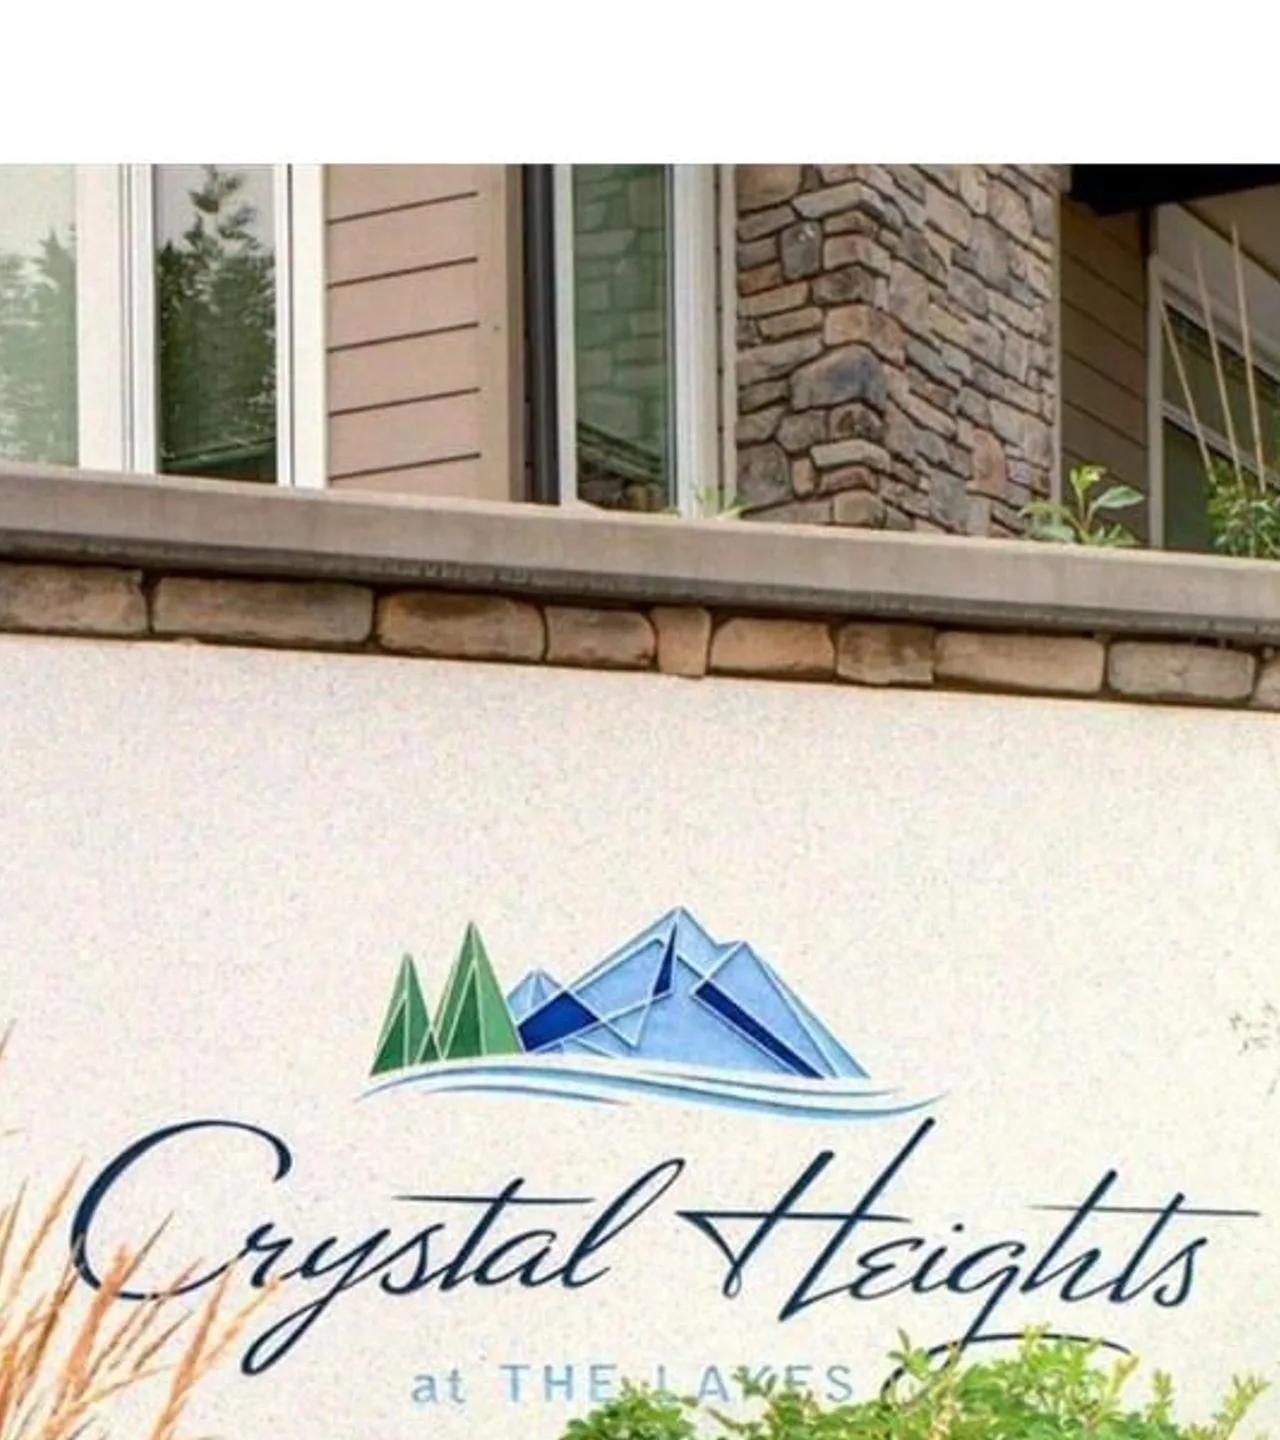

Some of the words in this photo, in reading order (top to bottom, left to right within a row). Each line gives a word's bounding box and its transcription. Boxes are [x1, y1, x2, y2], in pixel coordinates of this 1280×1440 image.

[70, 1119, 686, 1376] Crystal
[676, 1116, 1262, 1402] Heights
[411, 1366, 464, 1403] at
[499, 1363, 618, 1402] THE
